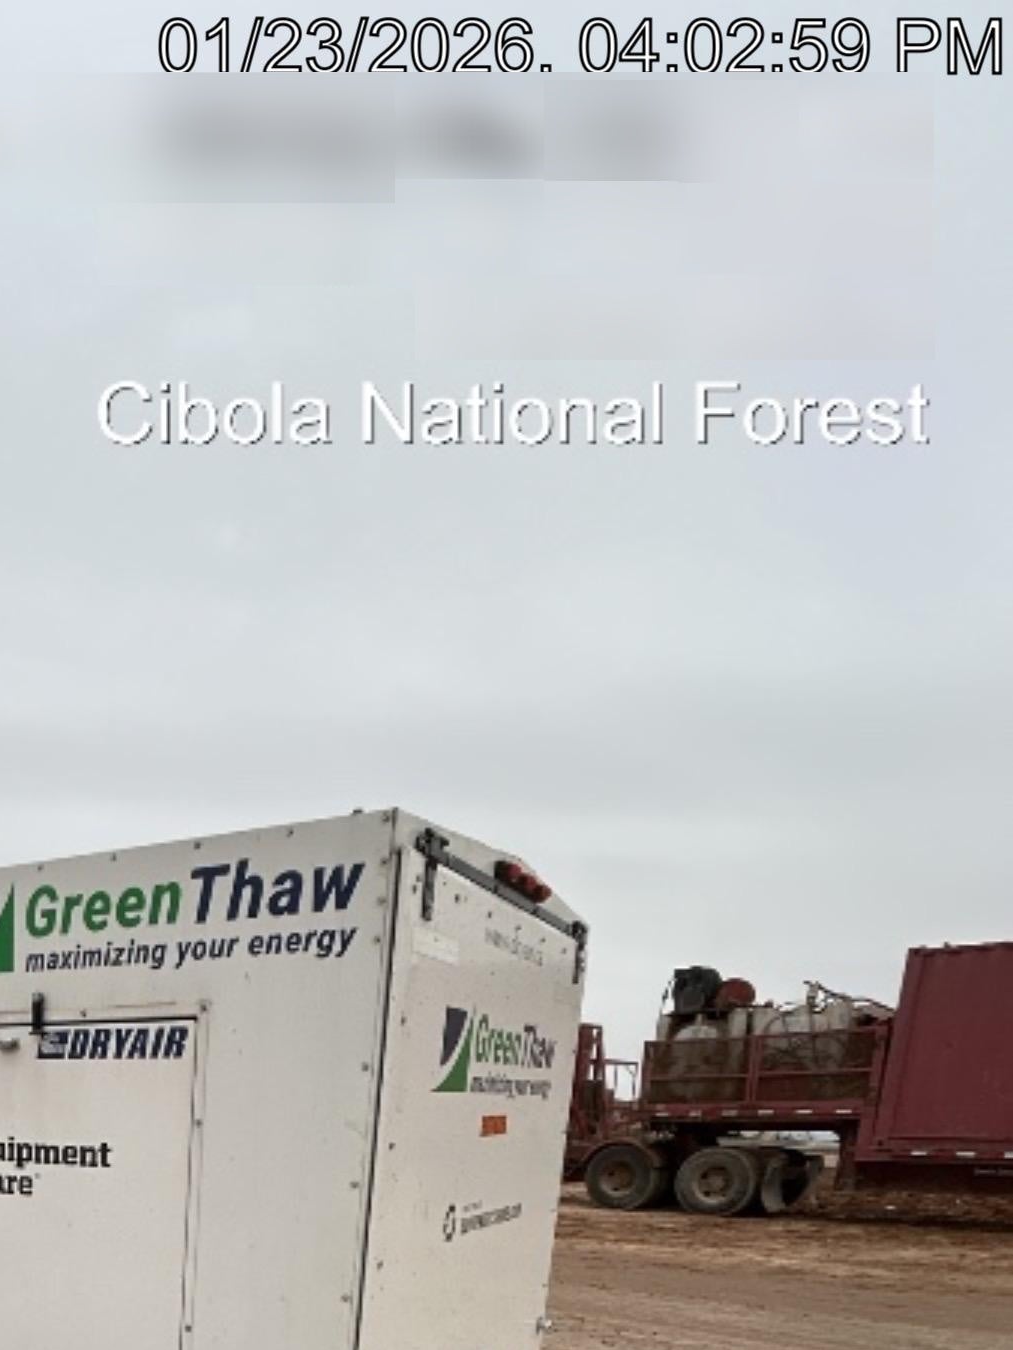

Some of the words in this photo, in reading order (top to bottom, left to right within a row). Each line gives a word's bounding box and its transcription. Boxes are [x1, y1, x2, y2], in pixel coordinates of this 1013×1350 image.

[25, 939, 169, 973] maximizing
[175, 935, 240, 970] your
[247, 926, 358, 959] energy
[67, 1025, 189, 1060] DRYAIR
